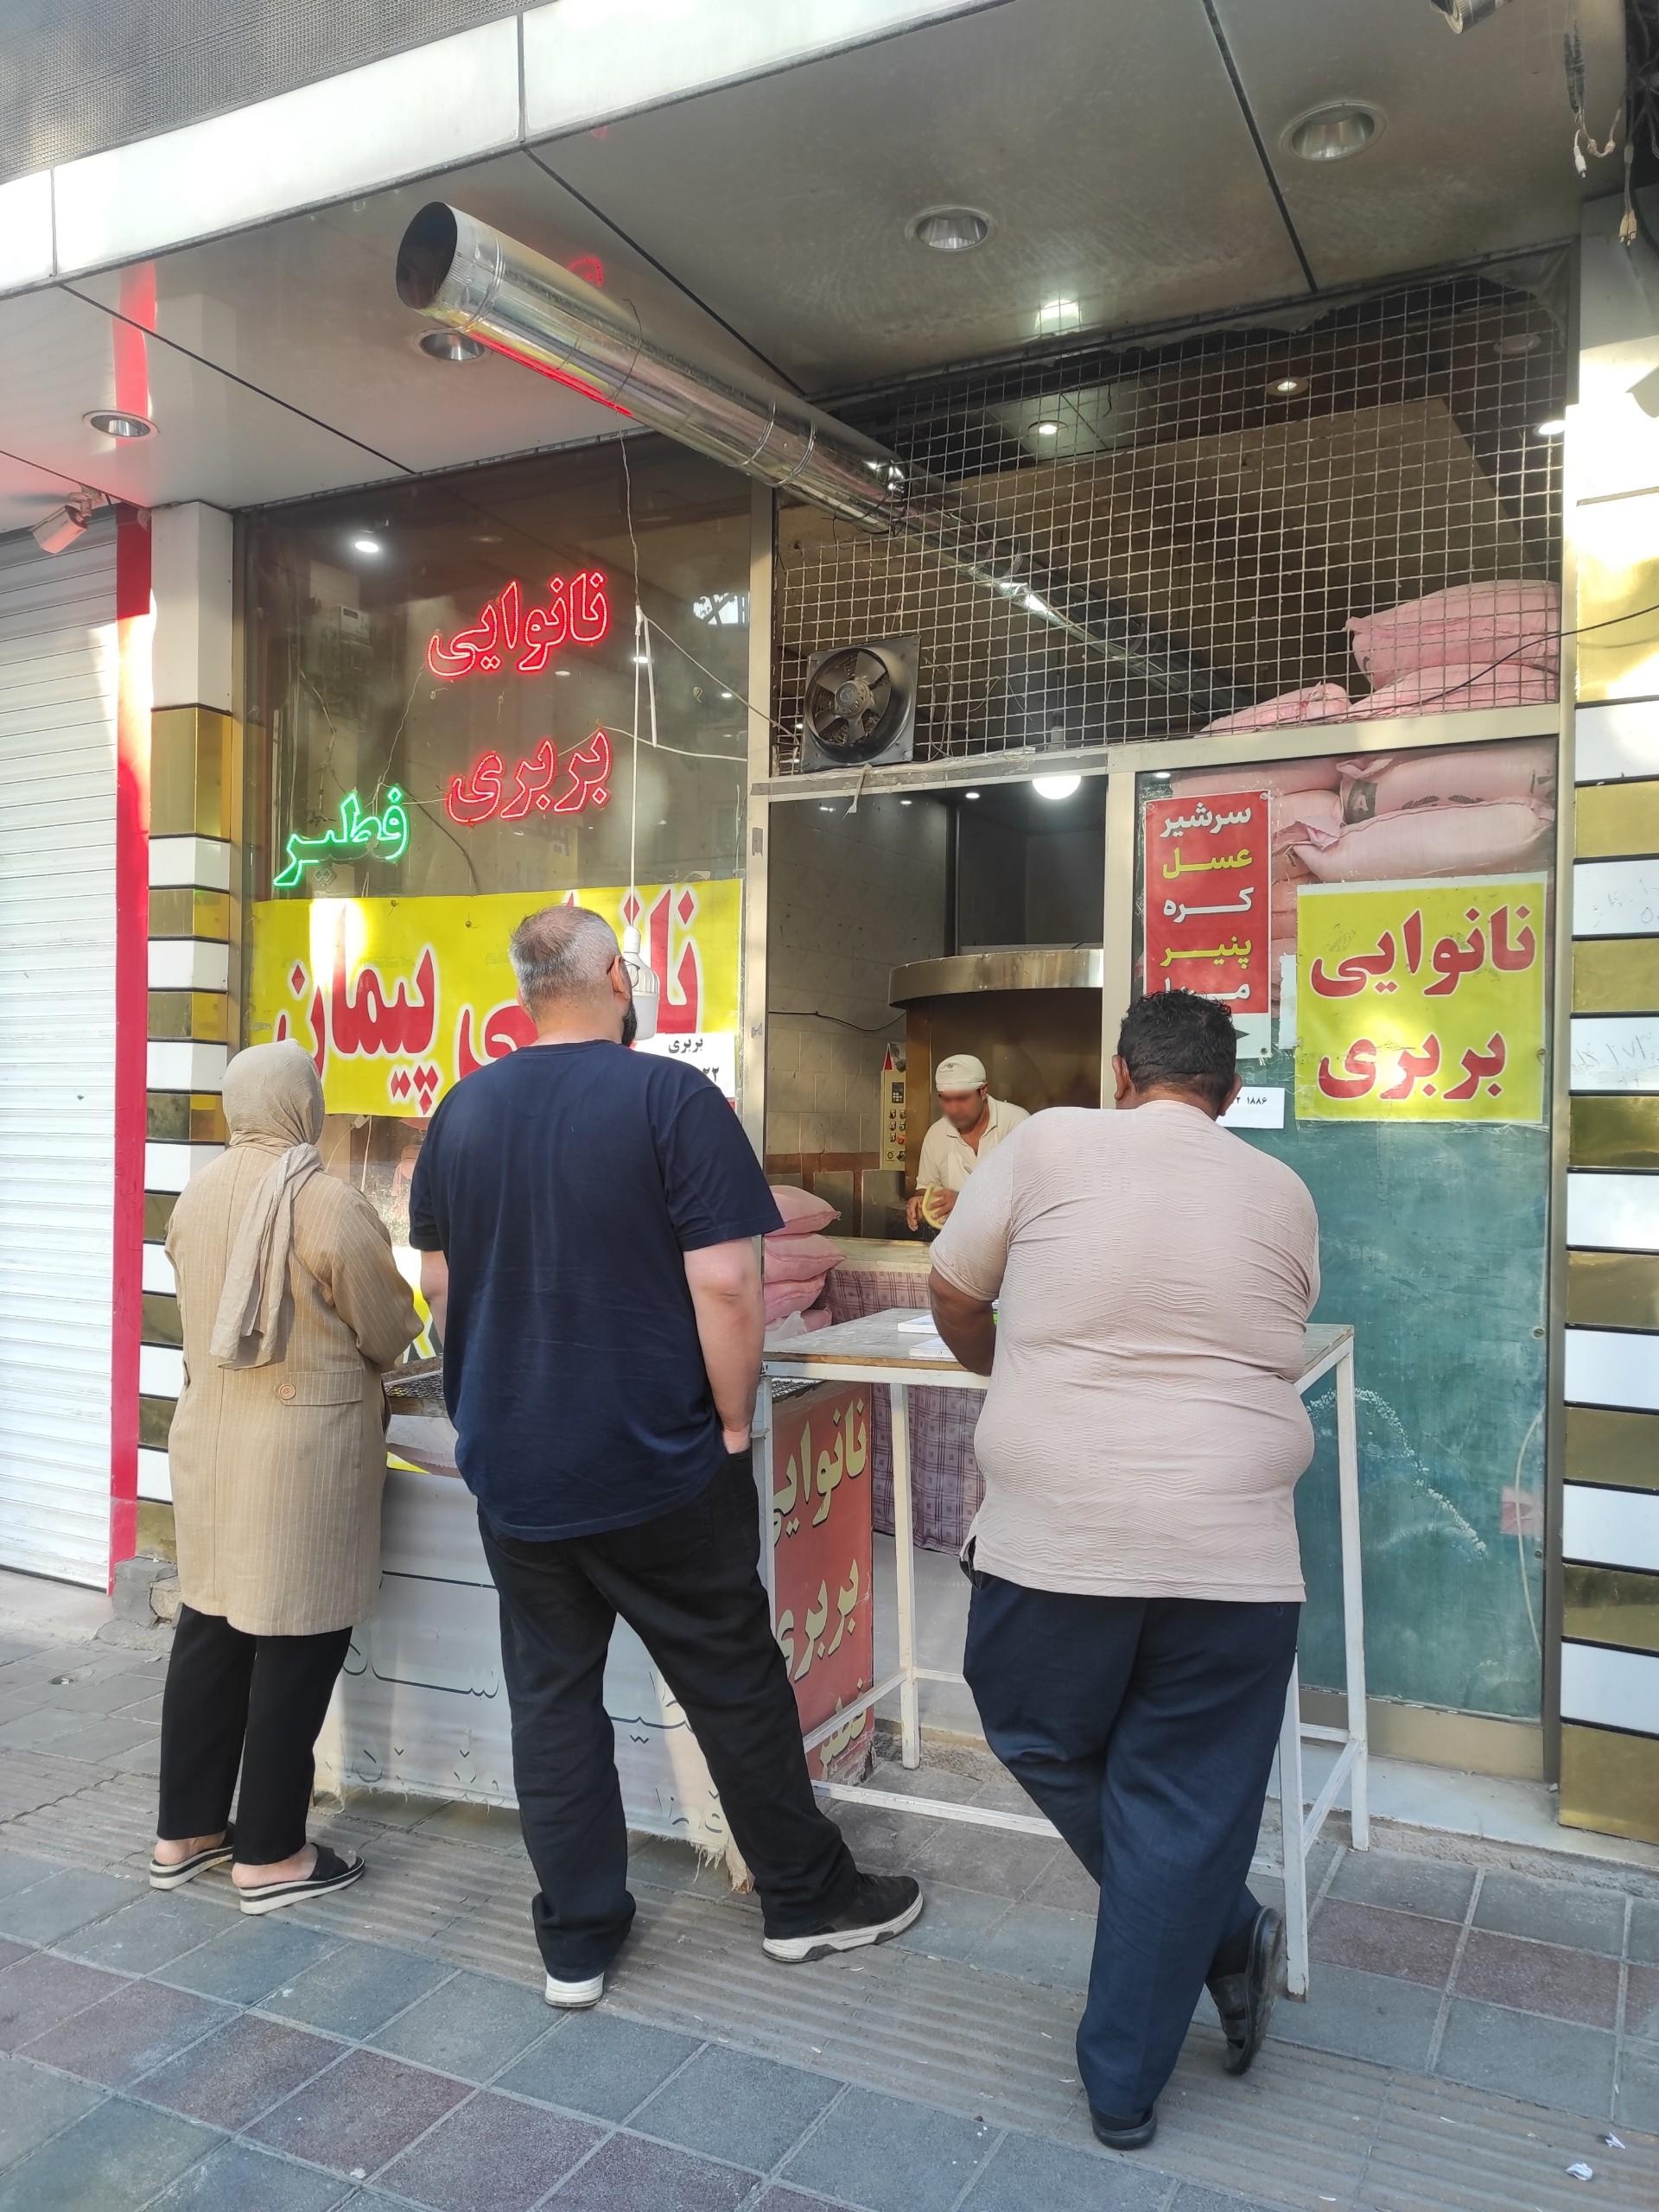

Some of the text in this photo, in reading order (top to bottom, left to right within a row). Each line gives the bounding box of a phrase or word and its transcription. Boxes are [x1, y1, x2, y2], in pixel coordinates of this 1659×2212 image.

[427, 570, 608, 677] نانوایی
[447, 730, 612, 824] بربری
[1160, 802, 1252, 838] سرشیر
[1162, 847, 1253, 880] عسل
[1163, 887, 1255, 924] کره
[1160, 935, 1252, 969] پنیر
[1309, 904, 1538, 999] نانوایی
[668, 1037, 703, 1054] بربری
[1318, 1031, 1506, 1101] بربری
